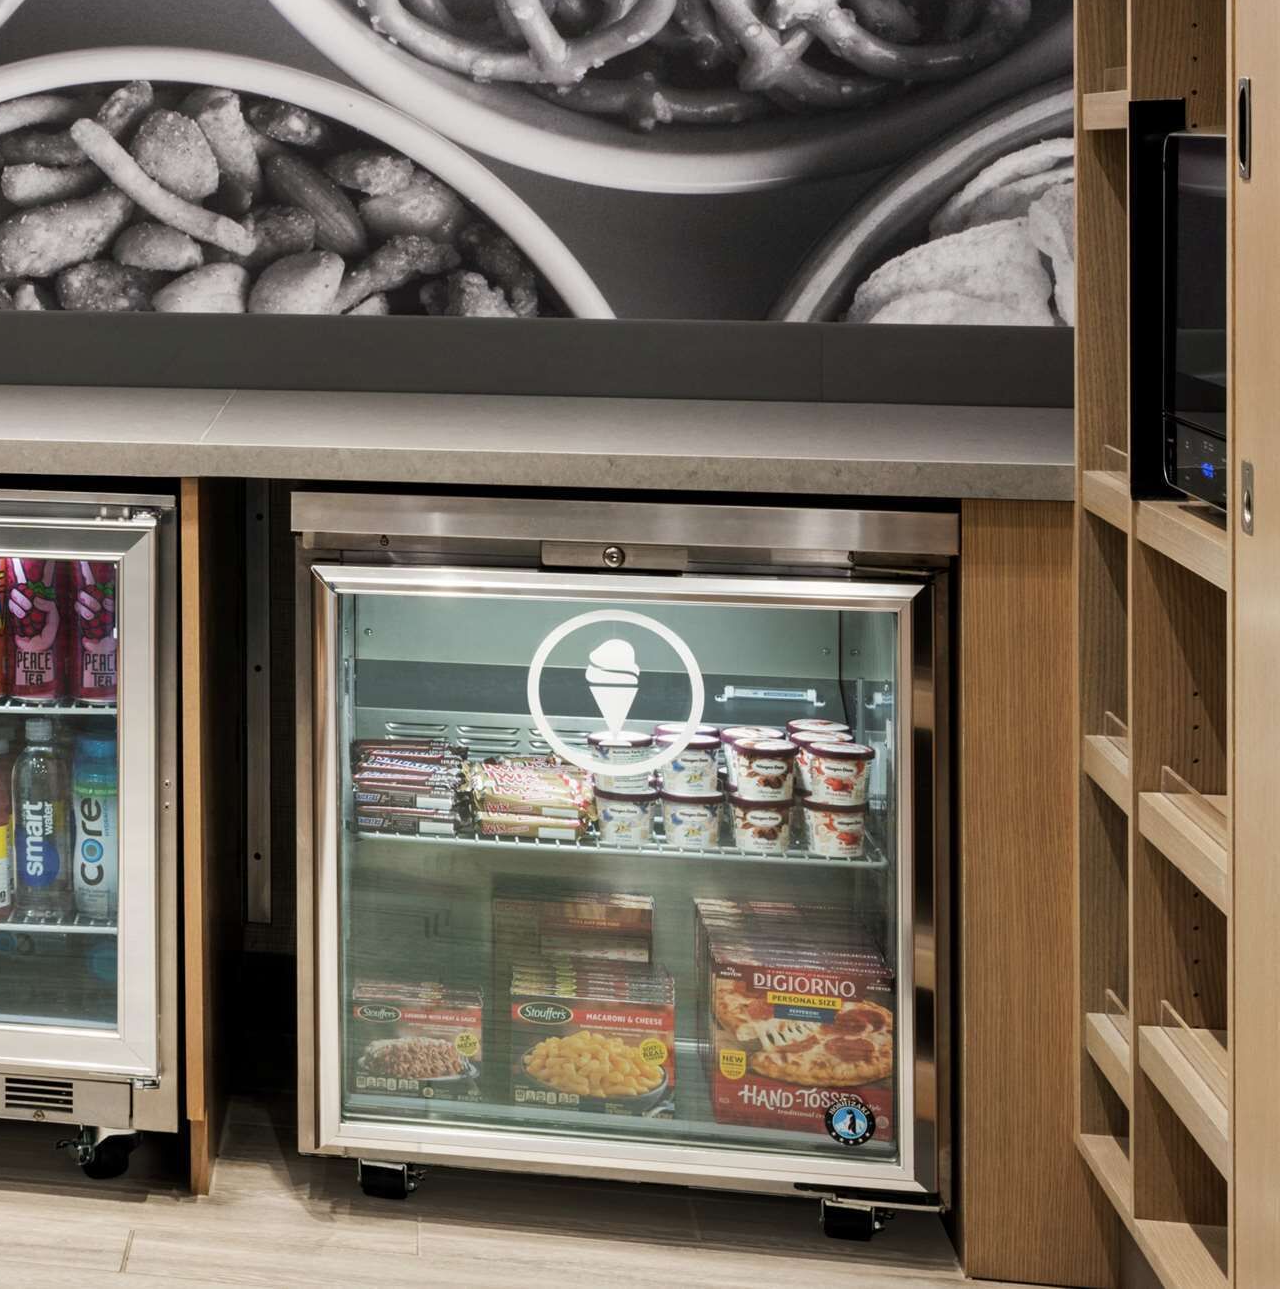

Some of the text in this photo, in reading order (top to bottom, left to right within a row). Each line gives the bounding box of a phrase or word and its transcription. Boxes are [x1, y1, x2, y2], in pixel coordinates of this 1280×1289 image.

[17, 651, 51, 670] PEACE
[84, 653, 117, 671] PEAC
[43, 802, 54, 835] water
[23, 801, 43, 877] smart
[80, 797, 104, 886] core
[772, 994, 837, 1007] PERSONAL SIZE
[586, 1014, 625, 1024] MACARONI
[634, 1016, 663, 1026] CHEESE
[722, 1055, 744, 1064] NEW
